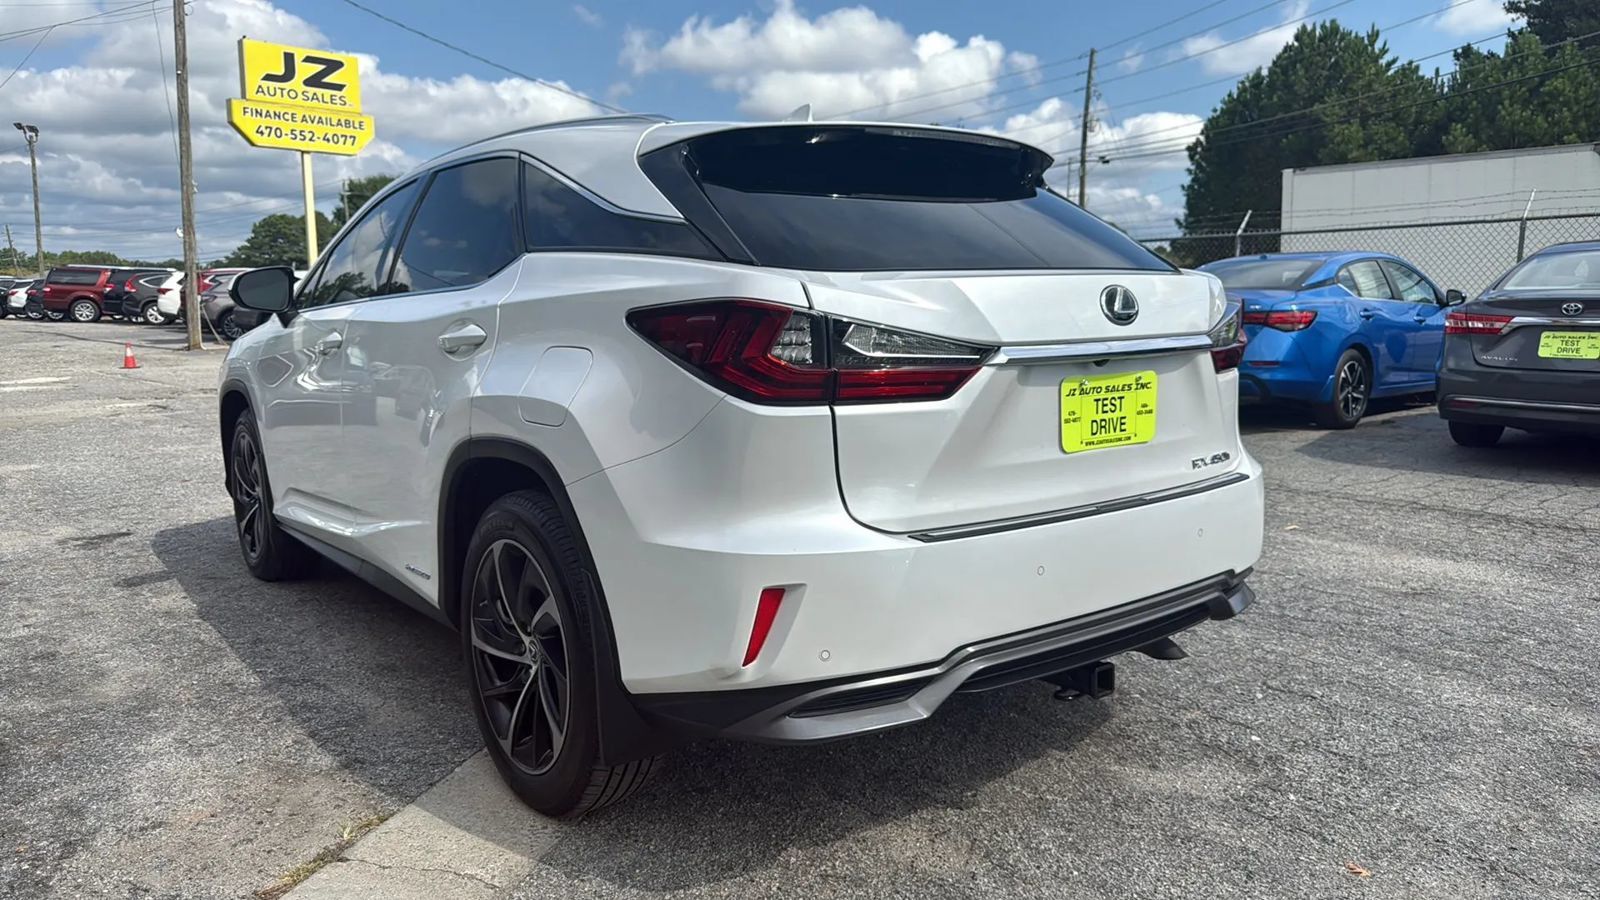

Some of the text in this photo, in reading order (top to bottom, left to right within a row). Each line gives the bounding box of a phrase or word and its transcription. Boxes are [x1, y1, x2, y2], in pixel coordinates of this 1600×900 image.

[260, 51, 347, 92] JZ
[255, 84, 299, 100] AUTO
[301, 90, 347, 107] SALES
[242, 106, 365, 131] FINANCE AVAILABLE
[255, 124, 357, 147] 470-552-4077
[1556, 346, 1581, 354] DRIVE
[1560, 339, 1581, 347] TEST
[1065, 388, 1078, 397] JZ
[1078, 386, 1103, 396] AUTO
[1103, 383, 1133, 394] SALES
[1093, 395, 1125, 415] TEST
[1090, 416, 1127, 436] DRIVE
